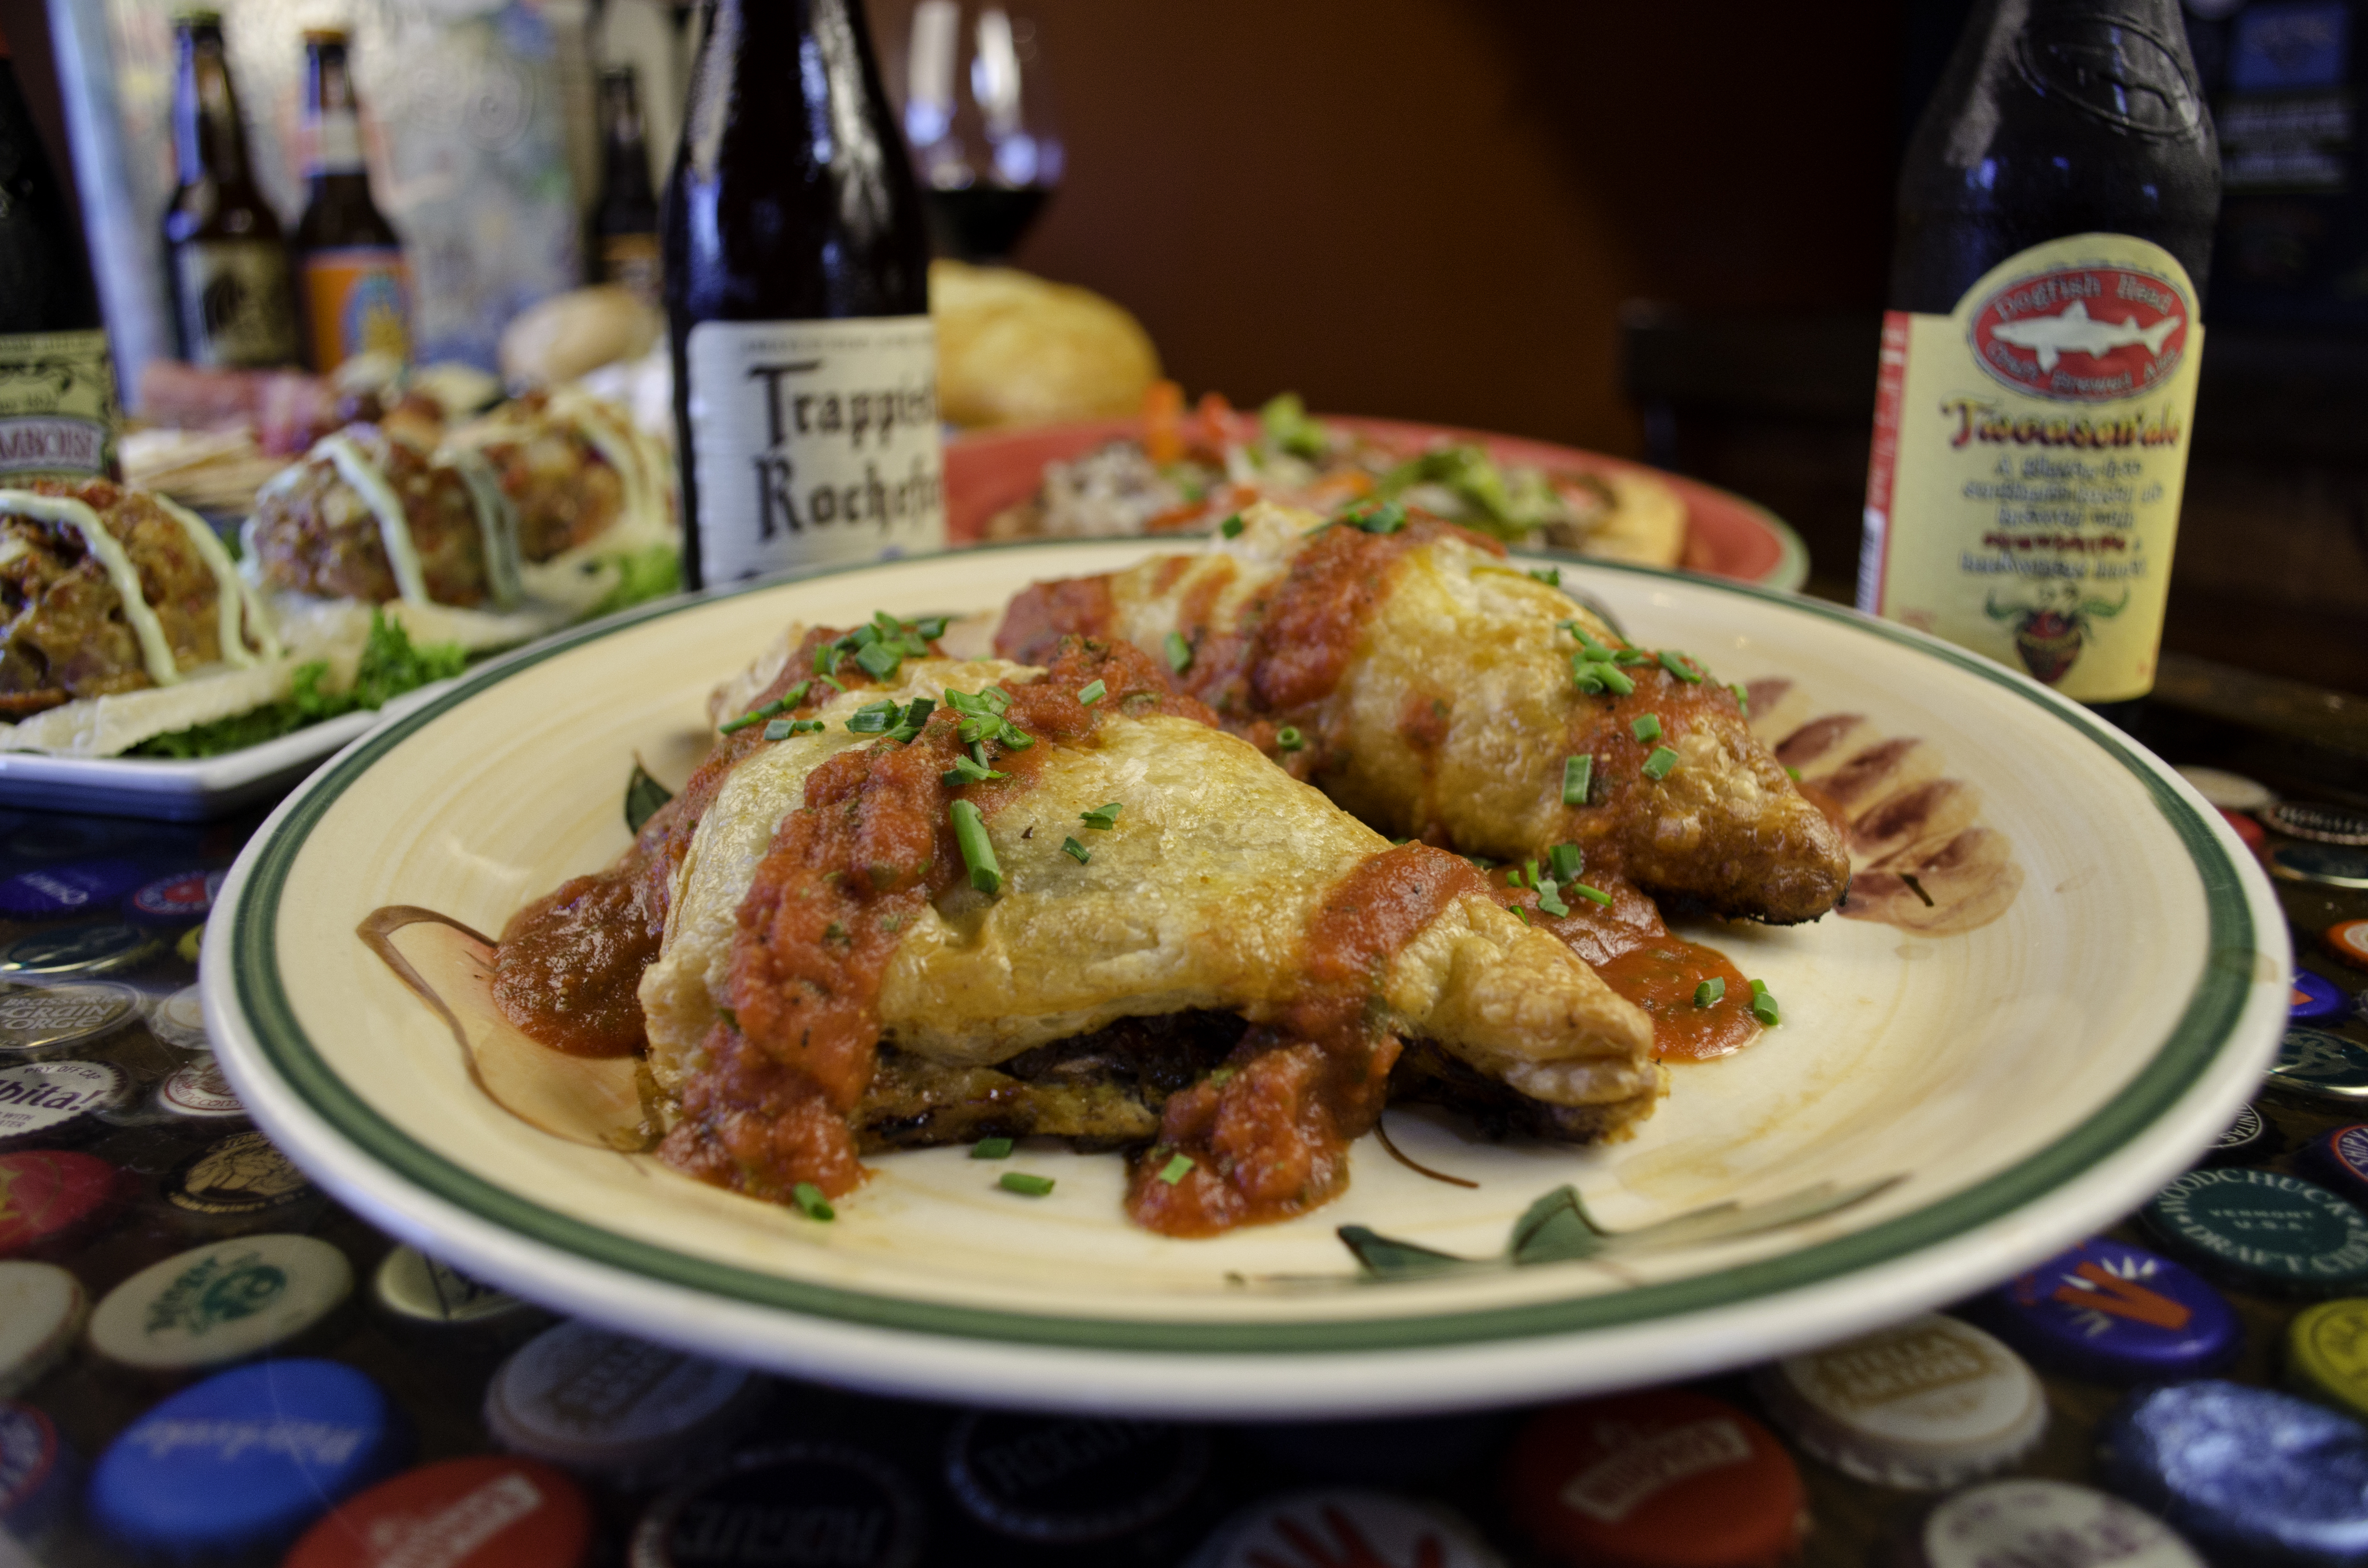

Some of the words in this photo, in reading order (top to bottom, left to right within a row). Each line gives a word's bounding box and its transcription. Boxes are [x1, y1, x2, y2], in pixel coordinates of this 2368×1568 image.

[1994, 272, 2102, 320] Dogfish
[2118, 274, 2173, 315] Head
[79, 1069, 101, 1080] CAP
[0, 1080, 107, 1111] bita!
[2219, 1106, 2257, 1143] UNITAS
[2342, 1127, 2368, 1166] SHIPY
[2158, 1168, 2356, 1215] WOODCHUCK
